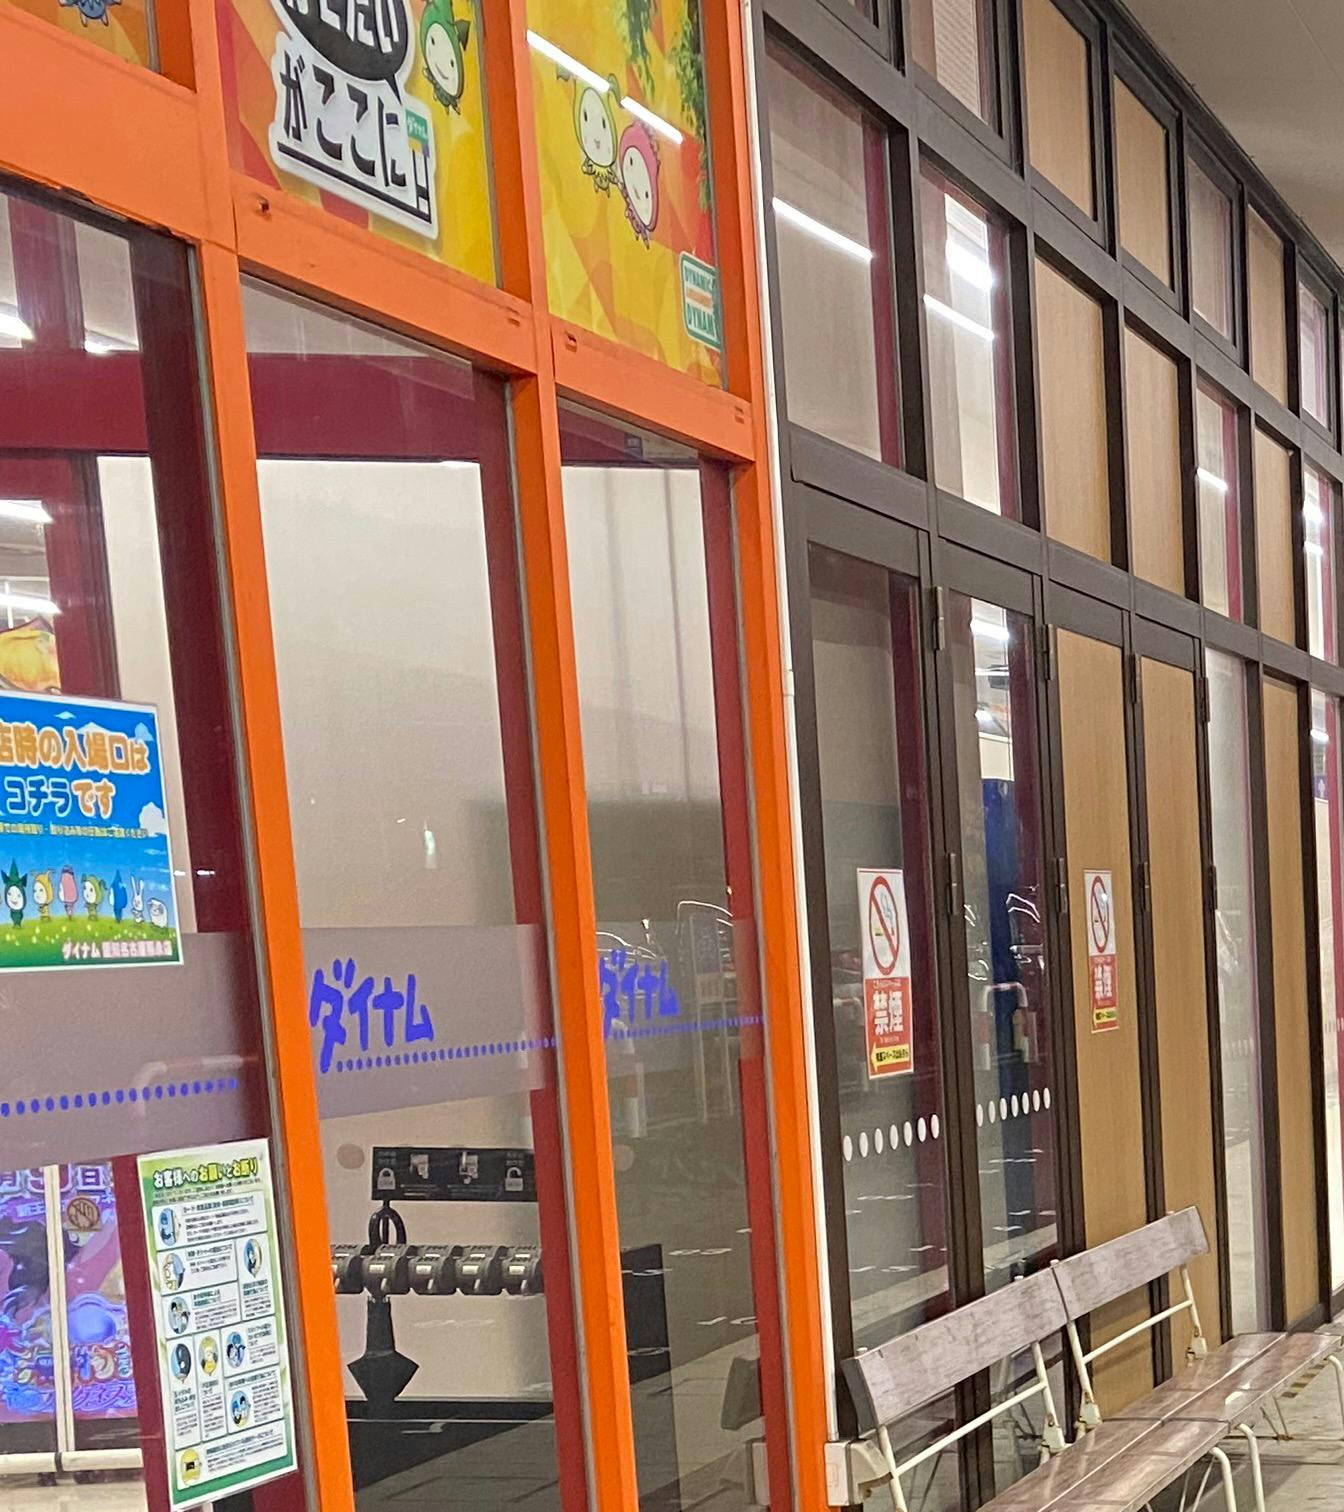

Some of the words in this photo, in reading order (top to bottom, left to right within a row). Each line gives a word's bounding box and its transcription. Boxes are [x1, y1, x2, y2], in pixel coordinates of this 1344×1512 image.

[279, 50, 408, 188] がここに
[4, 775, 116, 819] コチラです
[309, 957, 434, 1074] ダイナム
